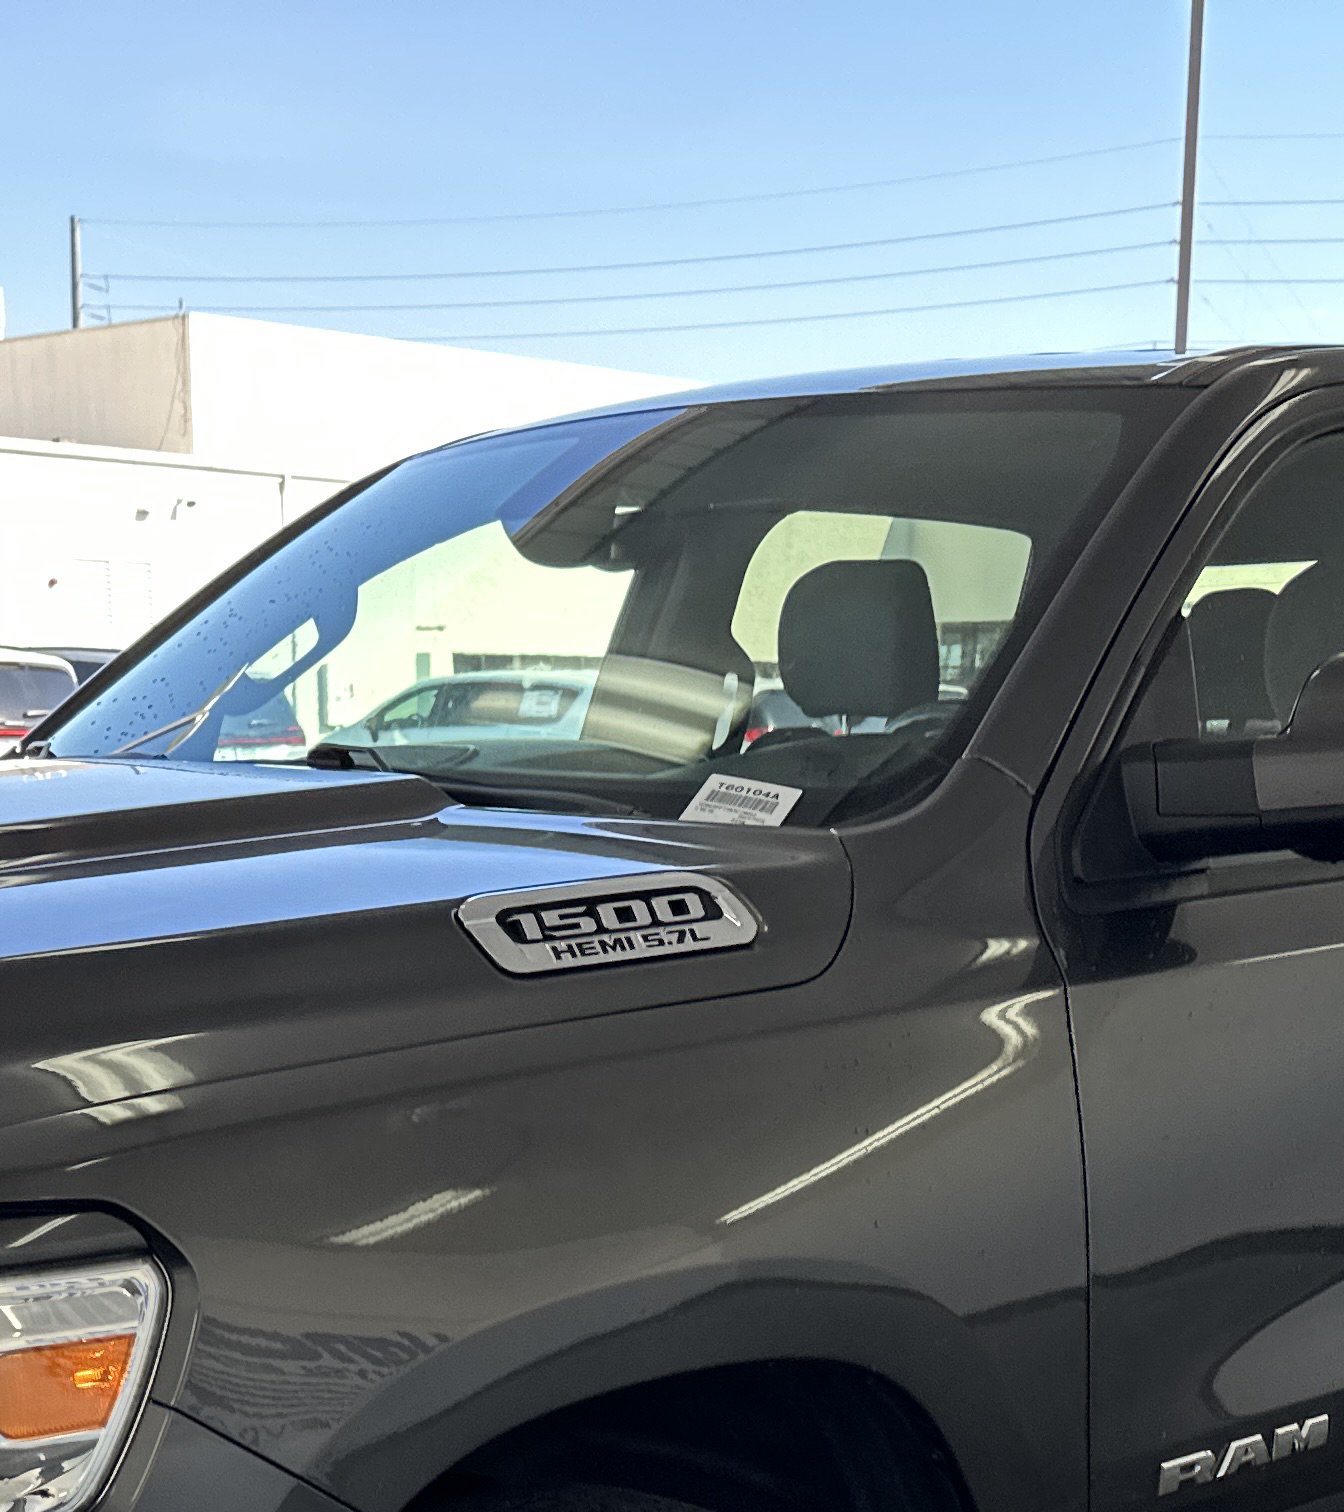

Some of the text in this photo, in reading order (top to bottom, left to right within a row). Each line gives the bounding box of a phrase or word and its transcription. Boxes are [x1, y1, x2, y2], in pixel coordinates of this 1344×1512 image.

[506, 892, 706, 941] 1500
[549, 927, 711, 961] HEMI 5.7L
[1158, 1413, 1329, 1497] RAM
